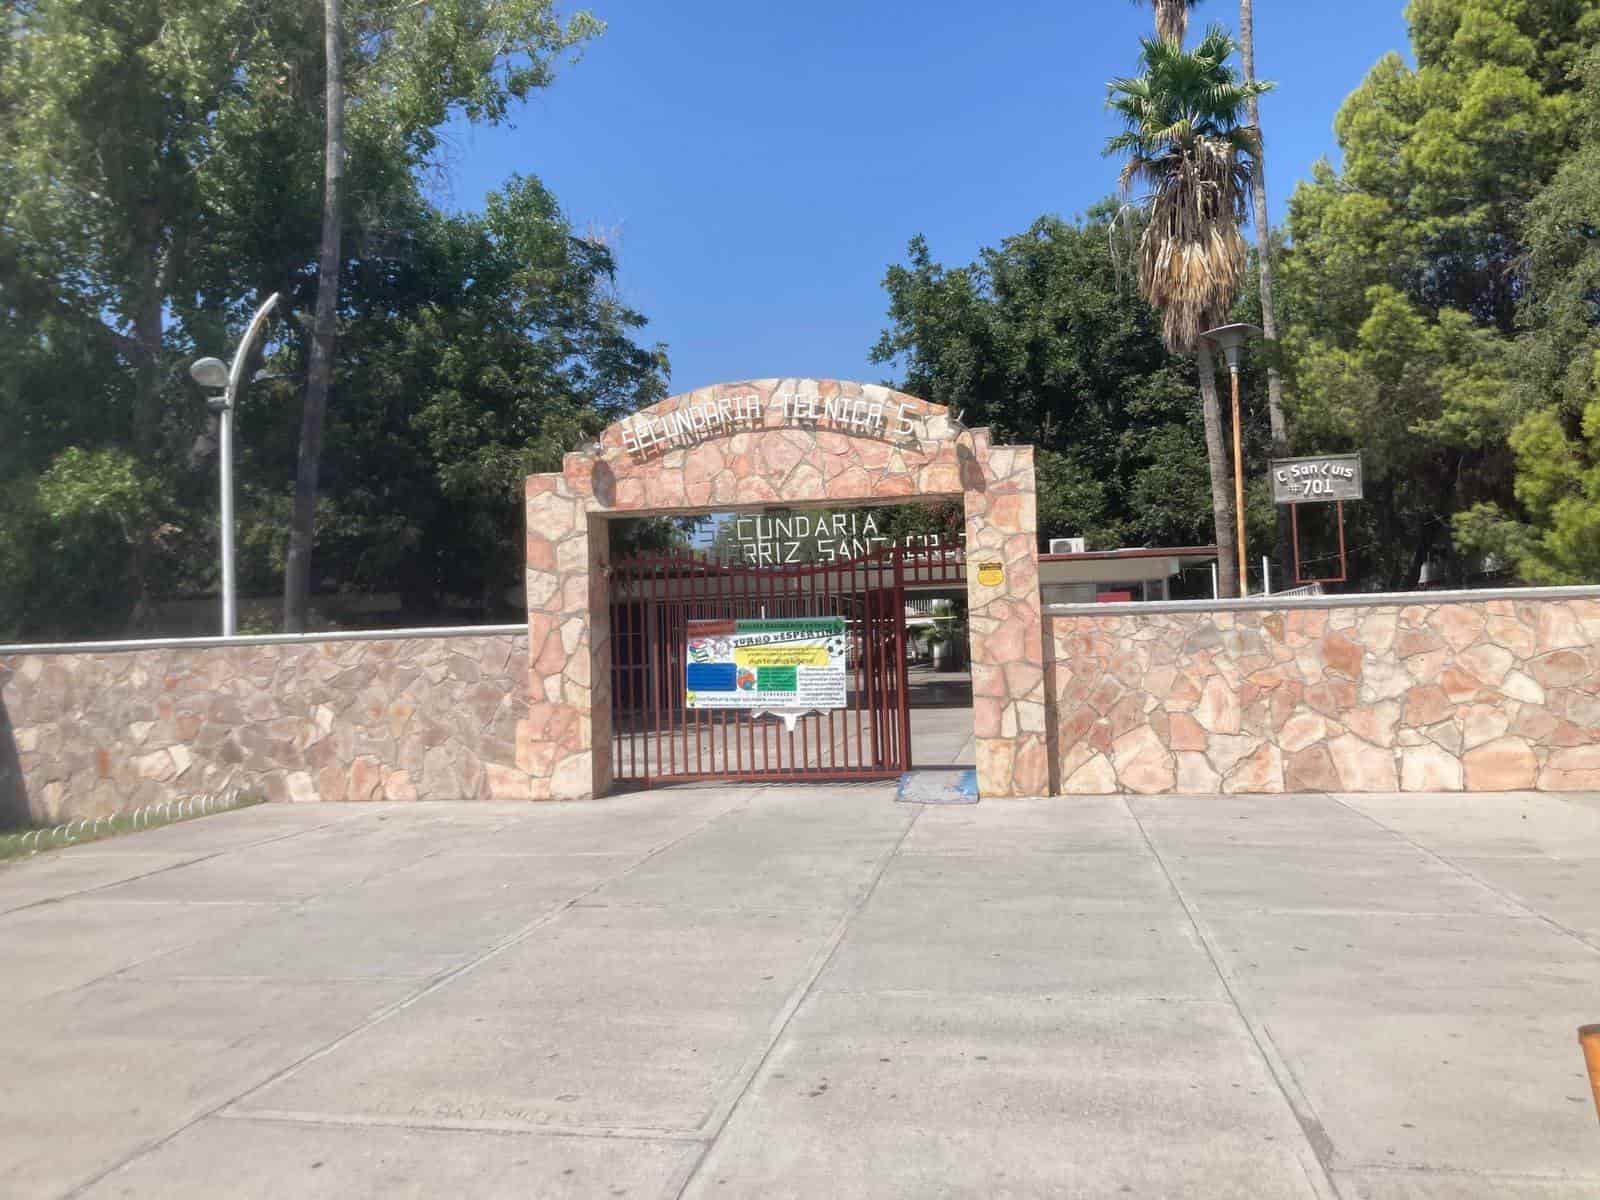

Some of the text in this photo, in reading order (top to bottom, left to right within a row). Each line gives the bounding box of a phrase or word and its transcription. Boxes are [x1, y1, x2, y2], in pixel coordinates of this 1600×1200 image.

[622, 395, 761, 453] SECUNDARIA
[783, 393, 882, 429] TECNICA
[1290, 463, 1318, 477] San
[1321, 462, 1354, 478] Luis
